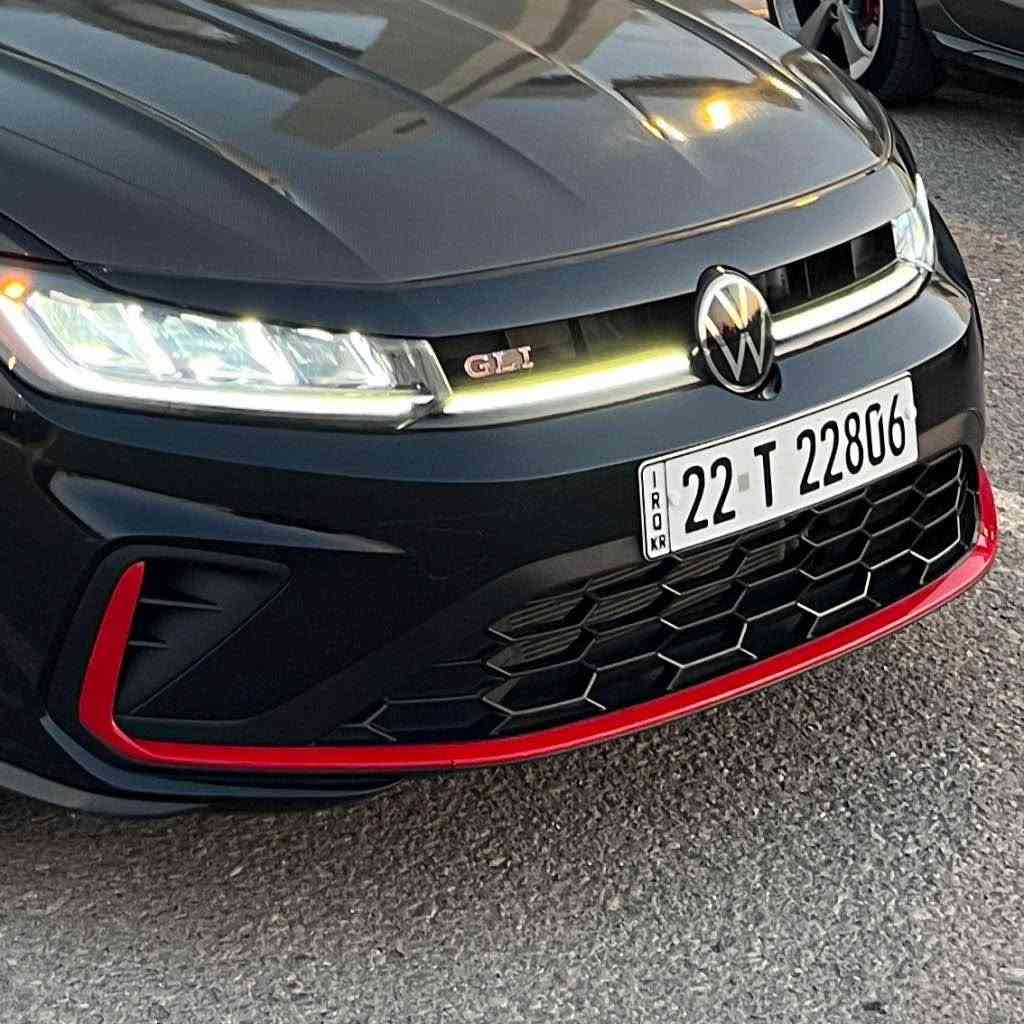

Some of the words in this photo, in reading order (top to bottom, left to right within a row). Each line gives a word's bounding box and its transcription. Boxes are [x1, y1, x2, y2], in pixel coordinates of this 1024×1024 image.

[464, 345, 535, 378] GLI
[699, 273, 771, 388] VW
[682, 458, 736, 534] 22
[753, 440, 777, 508] T
[796, 393, 906, 495] 22806
[651, 534, 666, 551] KR
